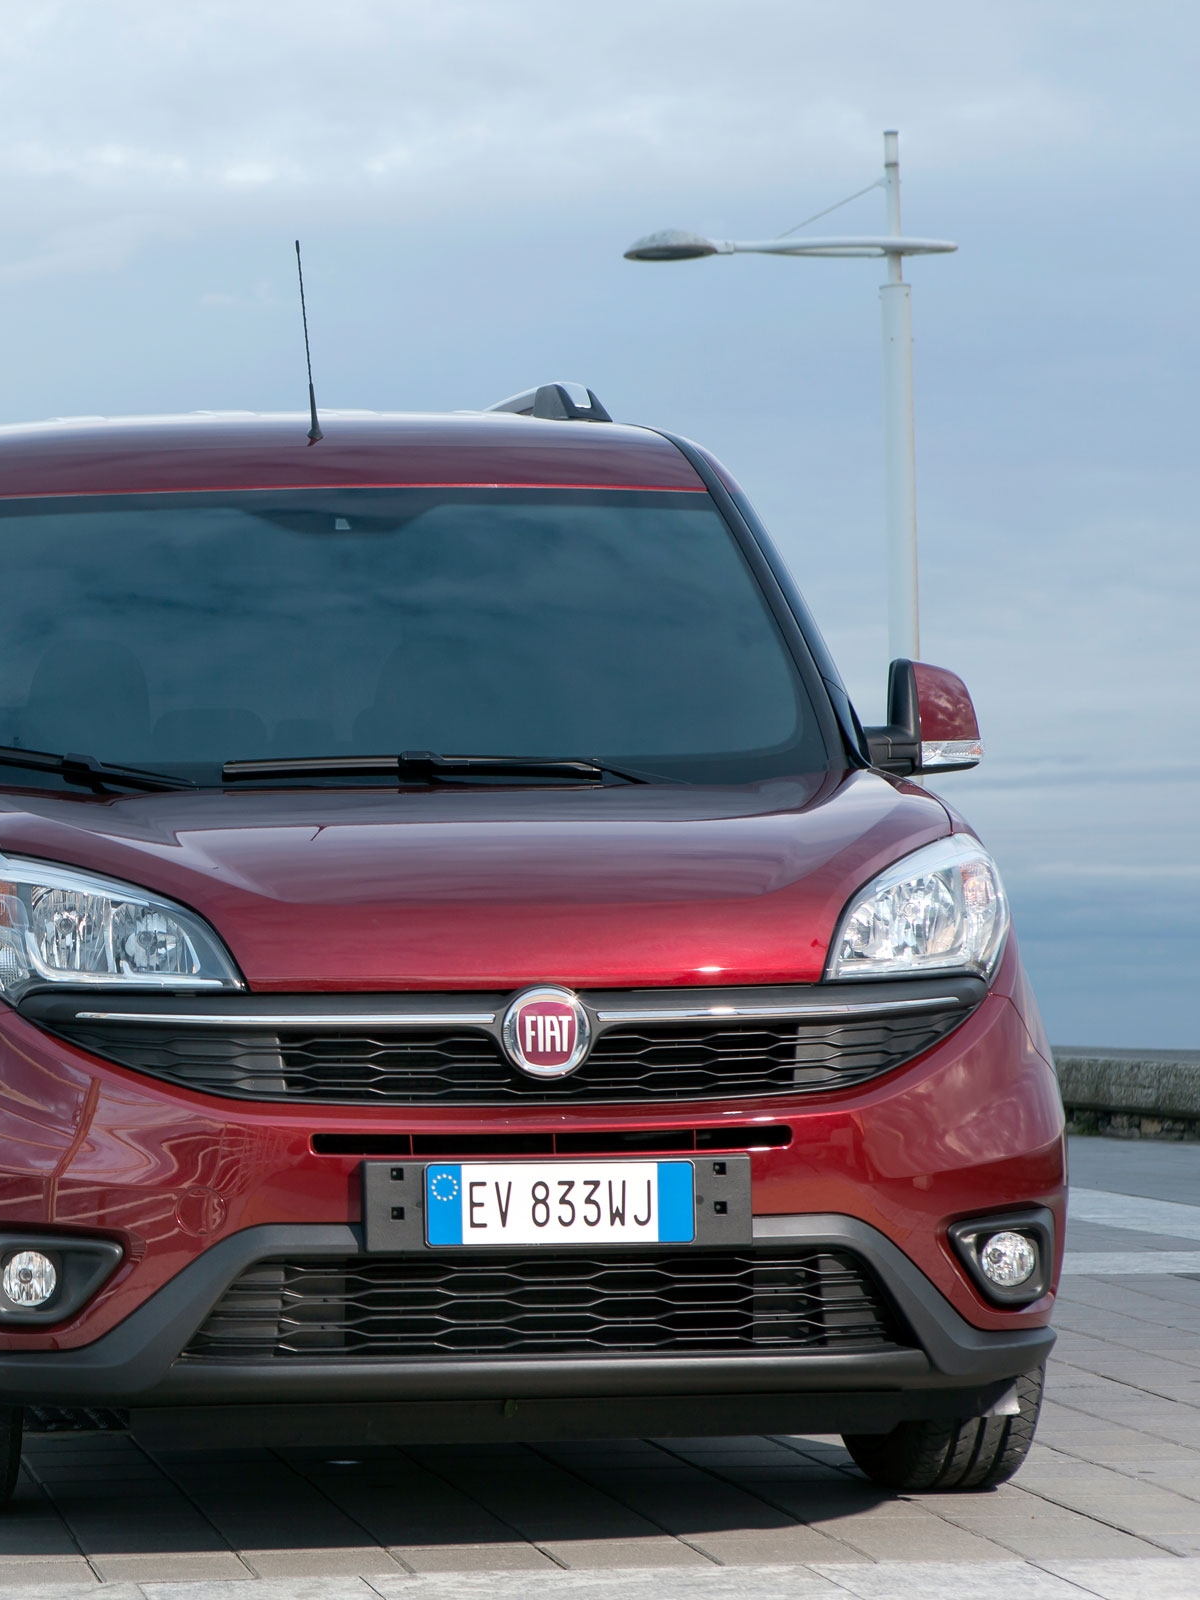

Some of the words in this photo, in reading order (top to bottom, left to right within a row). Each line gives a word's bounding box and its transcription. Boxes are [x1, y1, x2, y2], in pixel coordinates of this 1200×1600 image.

[525, 1015, 572, 1053] FIAT
[469, 1181, 512, 1228] EV
[531, 1179, 652, 1227] 833WJ
